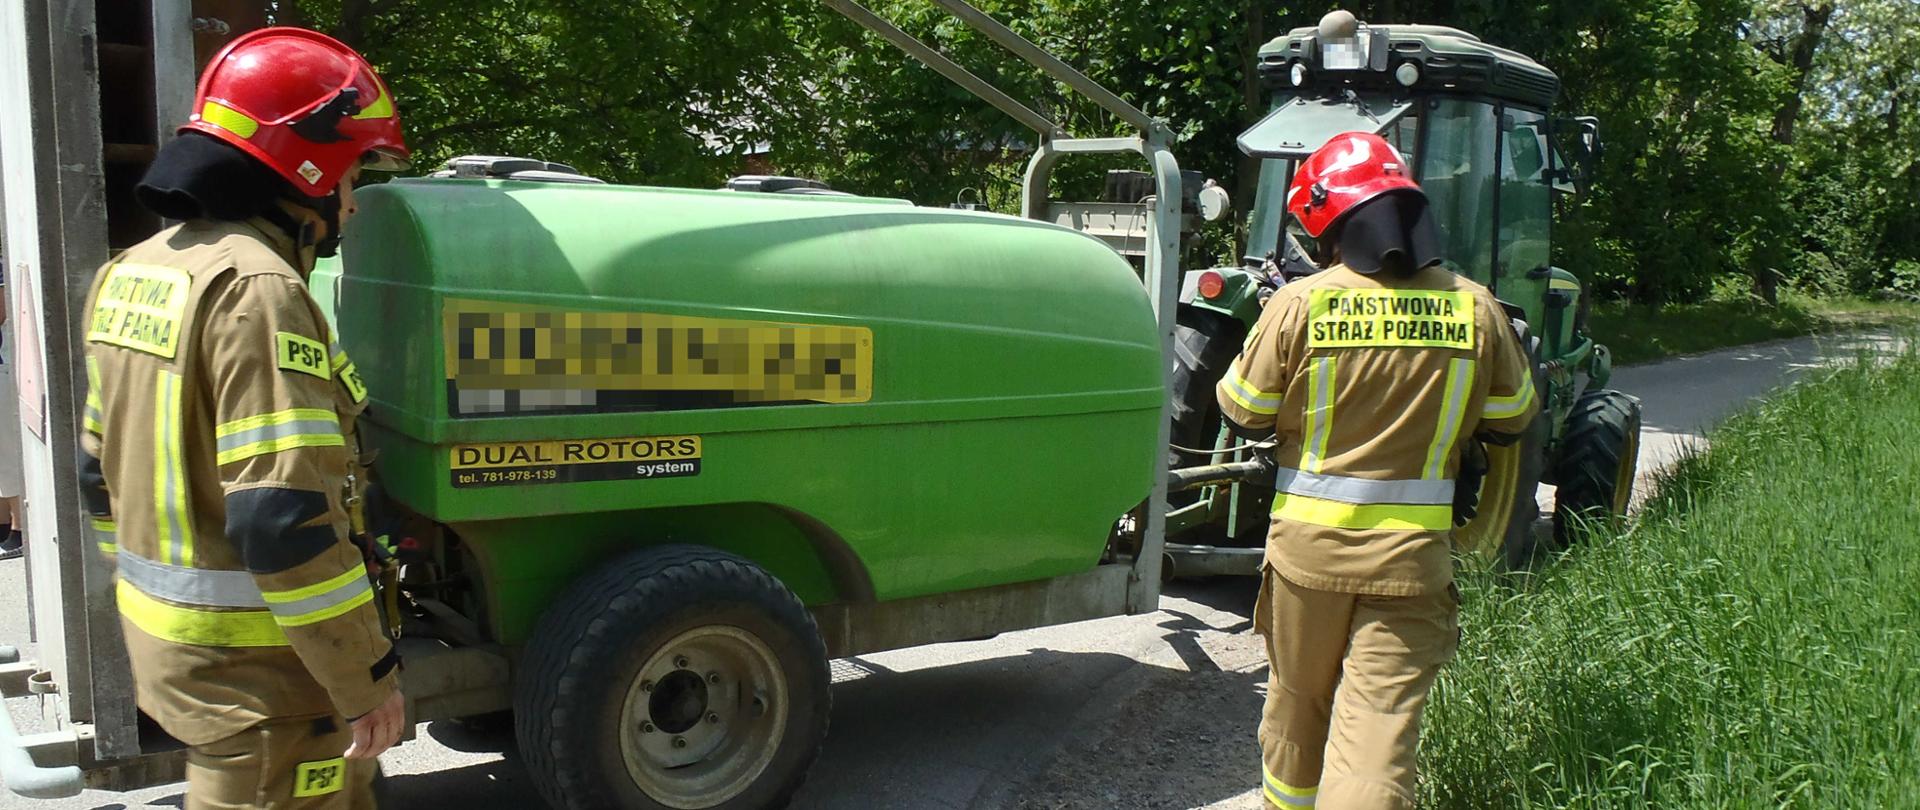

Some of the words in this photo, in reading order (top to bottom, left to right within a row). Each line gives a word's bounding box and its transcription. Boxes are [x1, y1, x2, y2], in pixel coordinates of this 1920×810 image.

[1328, 294, 1454, 317] PAŃSTWOWA
[1313, 320, 1374, 341] STRAŻ
[1383, 320, 1469, 343] POŻARNA
[288, 339, 323, 370] PSP
[459, 445, 553, 466] DUAL
[563, 439, 696, 461] ROTORS
[459, 473, 479, 484] tel.
[482, 469, 557, 483] 781-978-139
[636, 462, 695, 477] system
[304, 765, 337, 791] PSP
